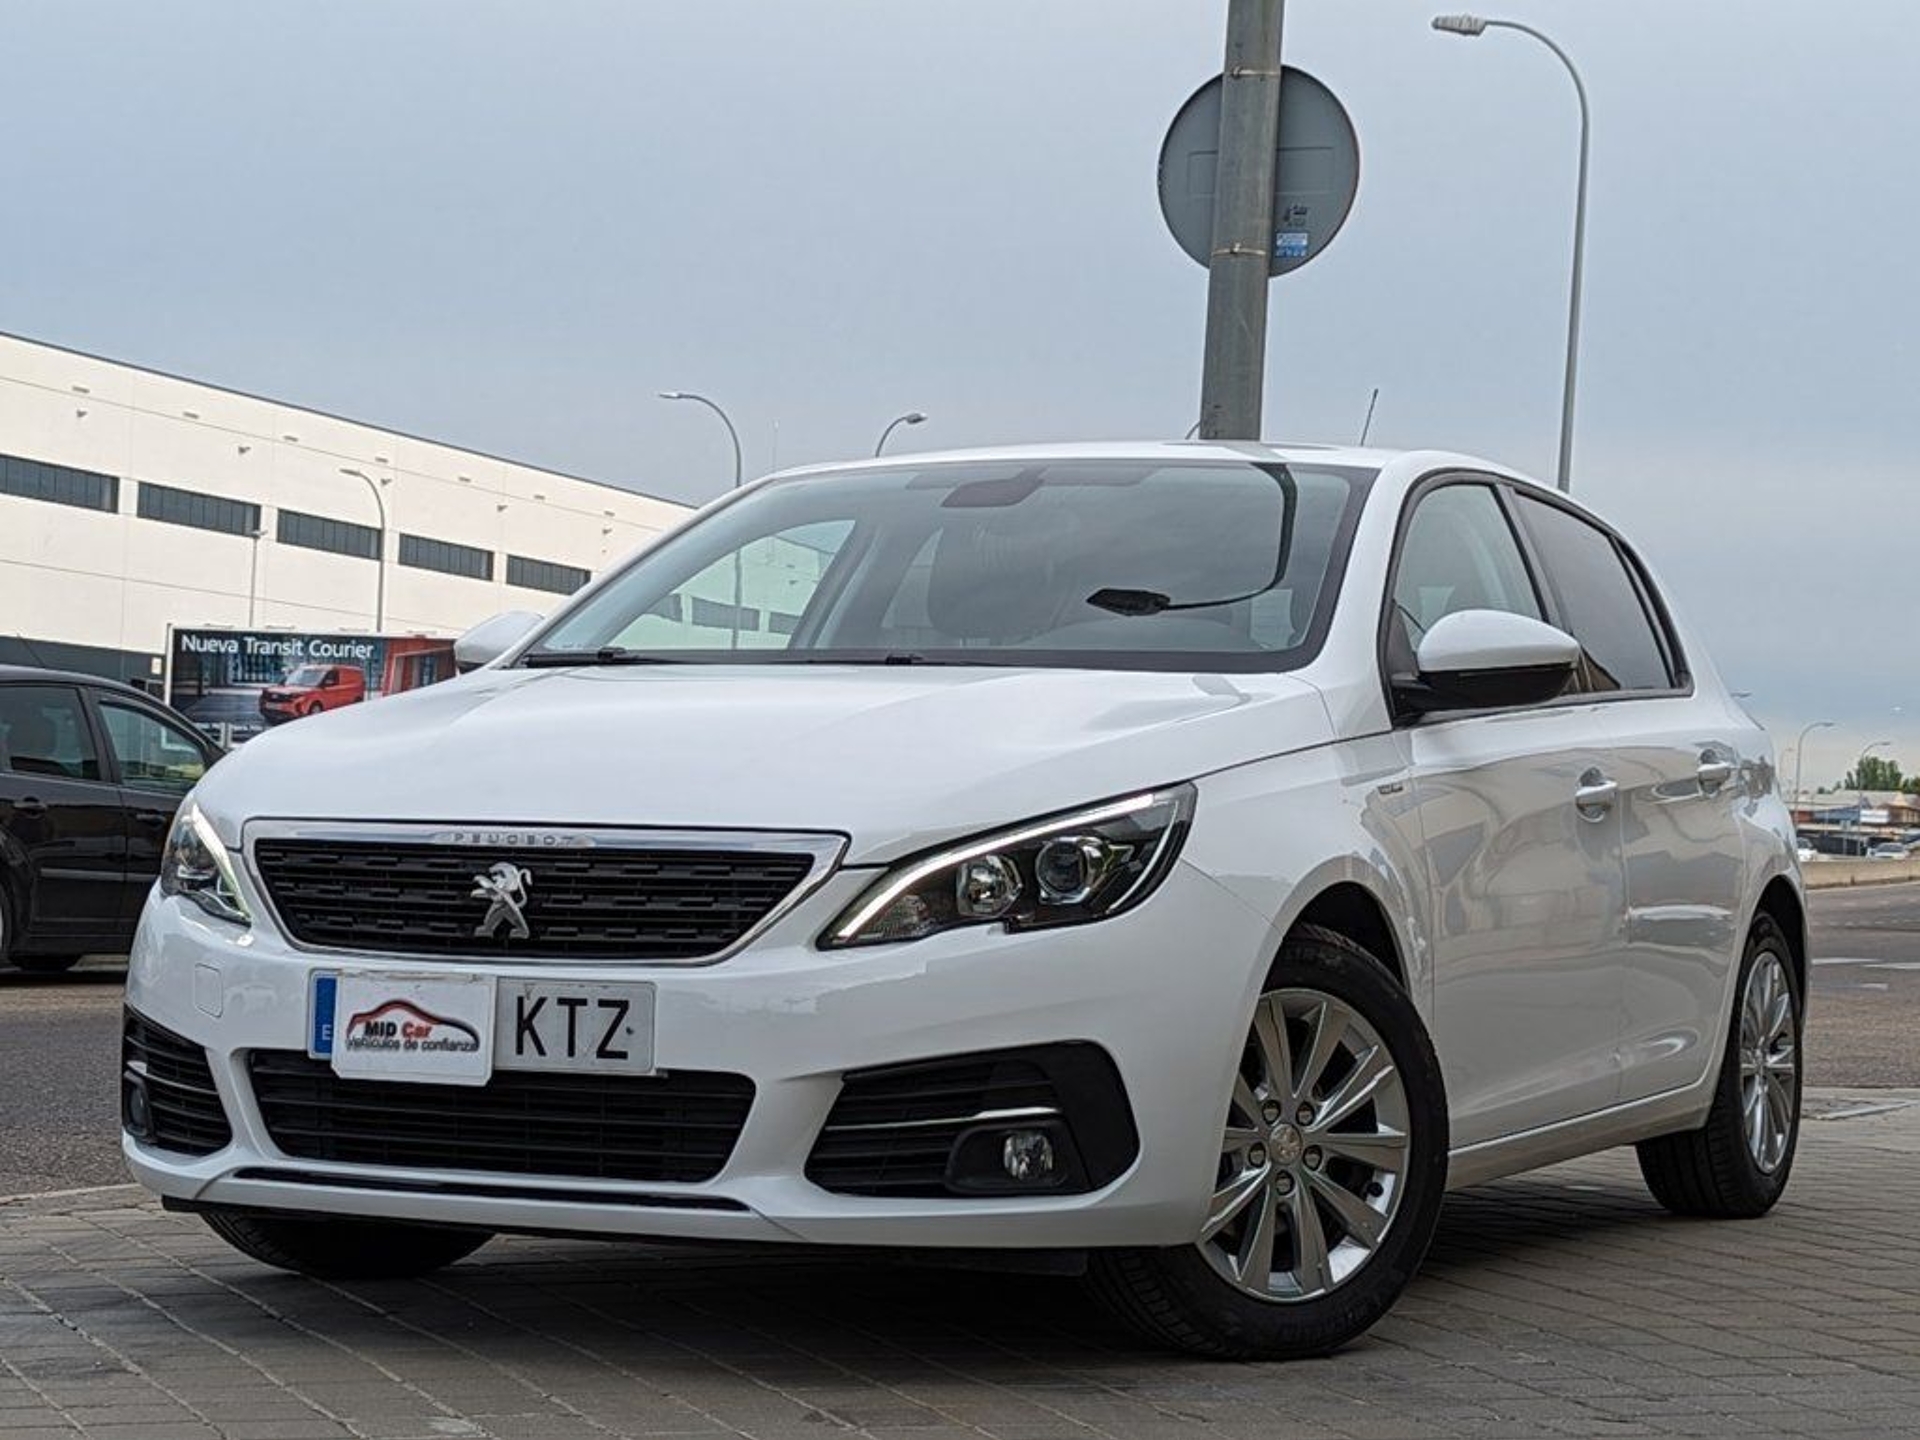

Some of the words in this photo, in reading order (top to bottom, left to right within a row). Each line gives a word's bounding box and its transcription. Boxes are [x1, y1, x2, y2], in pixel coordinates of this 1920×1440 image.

[181, 635, 238, 653] Nueva
[244, 637, 304, 656] Transit
[309, 639, 374, 658] Courier
[454, 832, 573, 846] PEUGEOT
[322, 1025, 331, 1040] E
[365, 1021, 397, 1037] MID
[402, 1021, 433, 1038] Car
[515, 996, 630, 1059] KTZ
[403, 1037, 418, 1050] de
